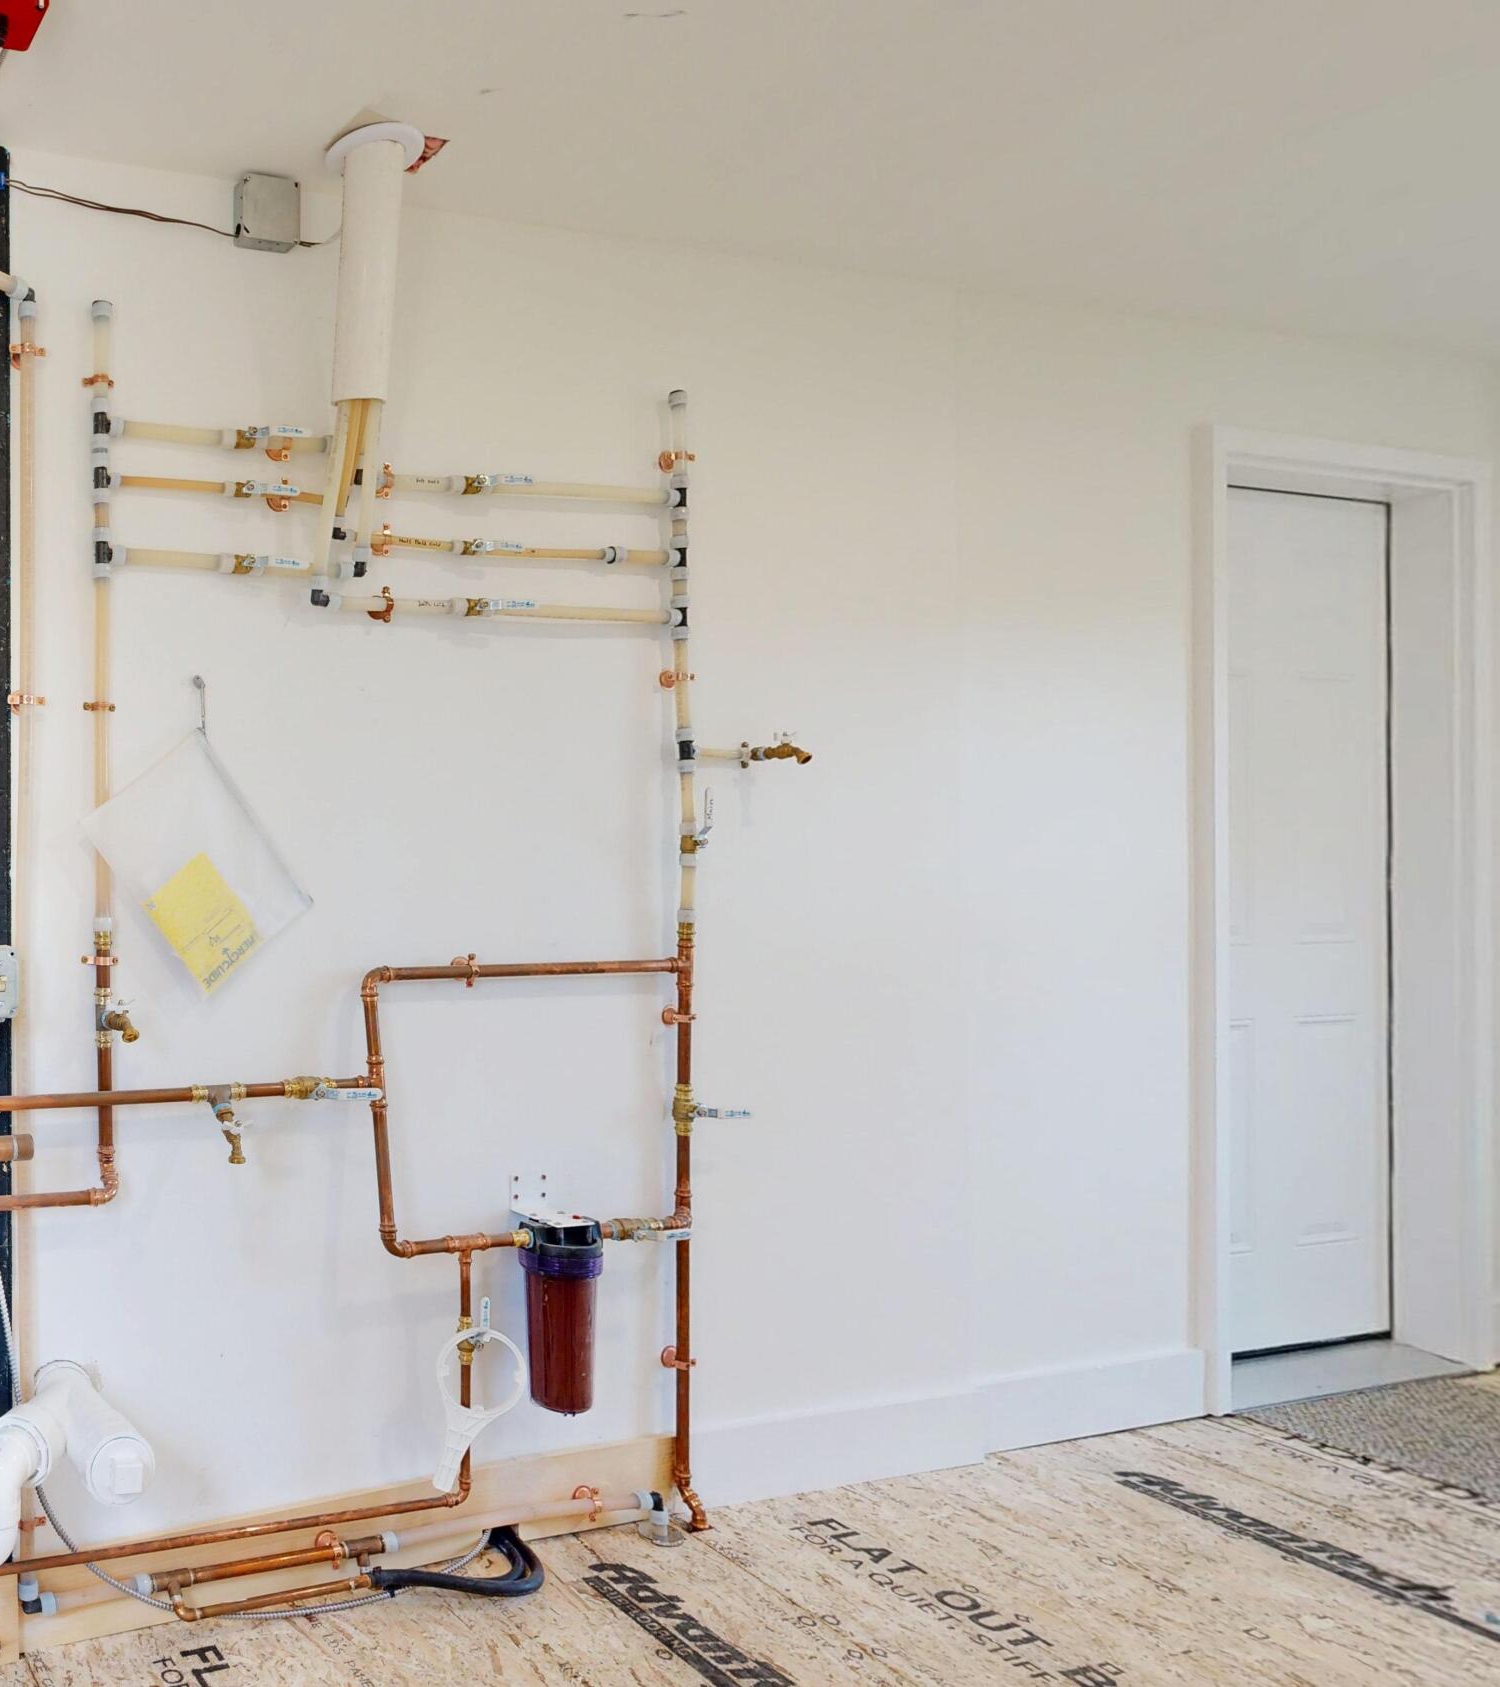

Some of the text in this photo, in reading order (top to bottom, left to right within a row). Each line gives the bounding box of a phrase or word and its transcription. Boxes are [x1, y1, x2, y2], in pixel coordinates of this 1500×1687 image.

[588, 1562, 797, 1687] AdvanT
[595, 1583, 696, 1659] SUBFLOORING
[789, 1526, 843, 1556] FOR
[840, 1558, 864, 1570] A
[968, 1633, 1059, 1684] STIFF
[807, 1518, 928, 1575] FLAT
[934, 1590, 1054, 1647] OUT
[152, 1655, 191, 1687] FO
